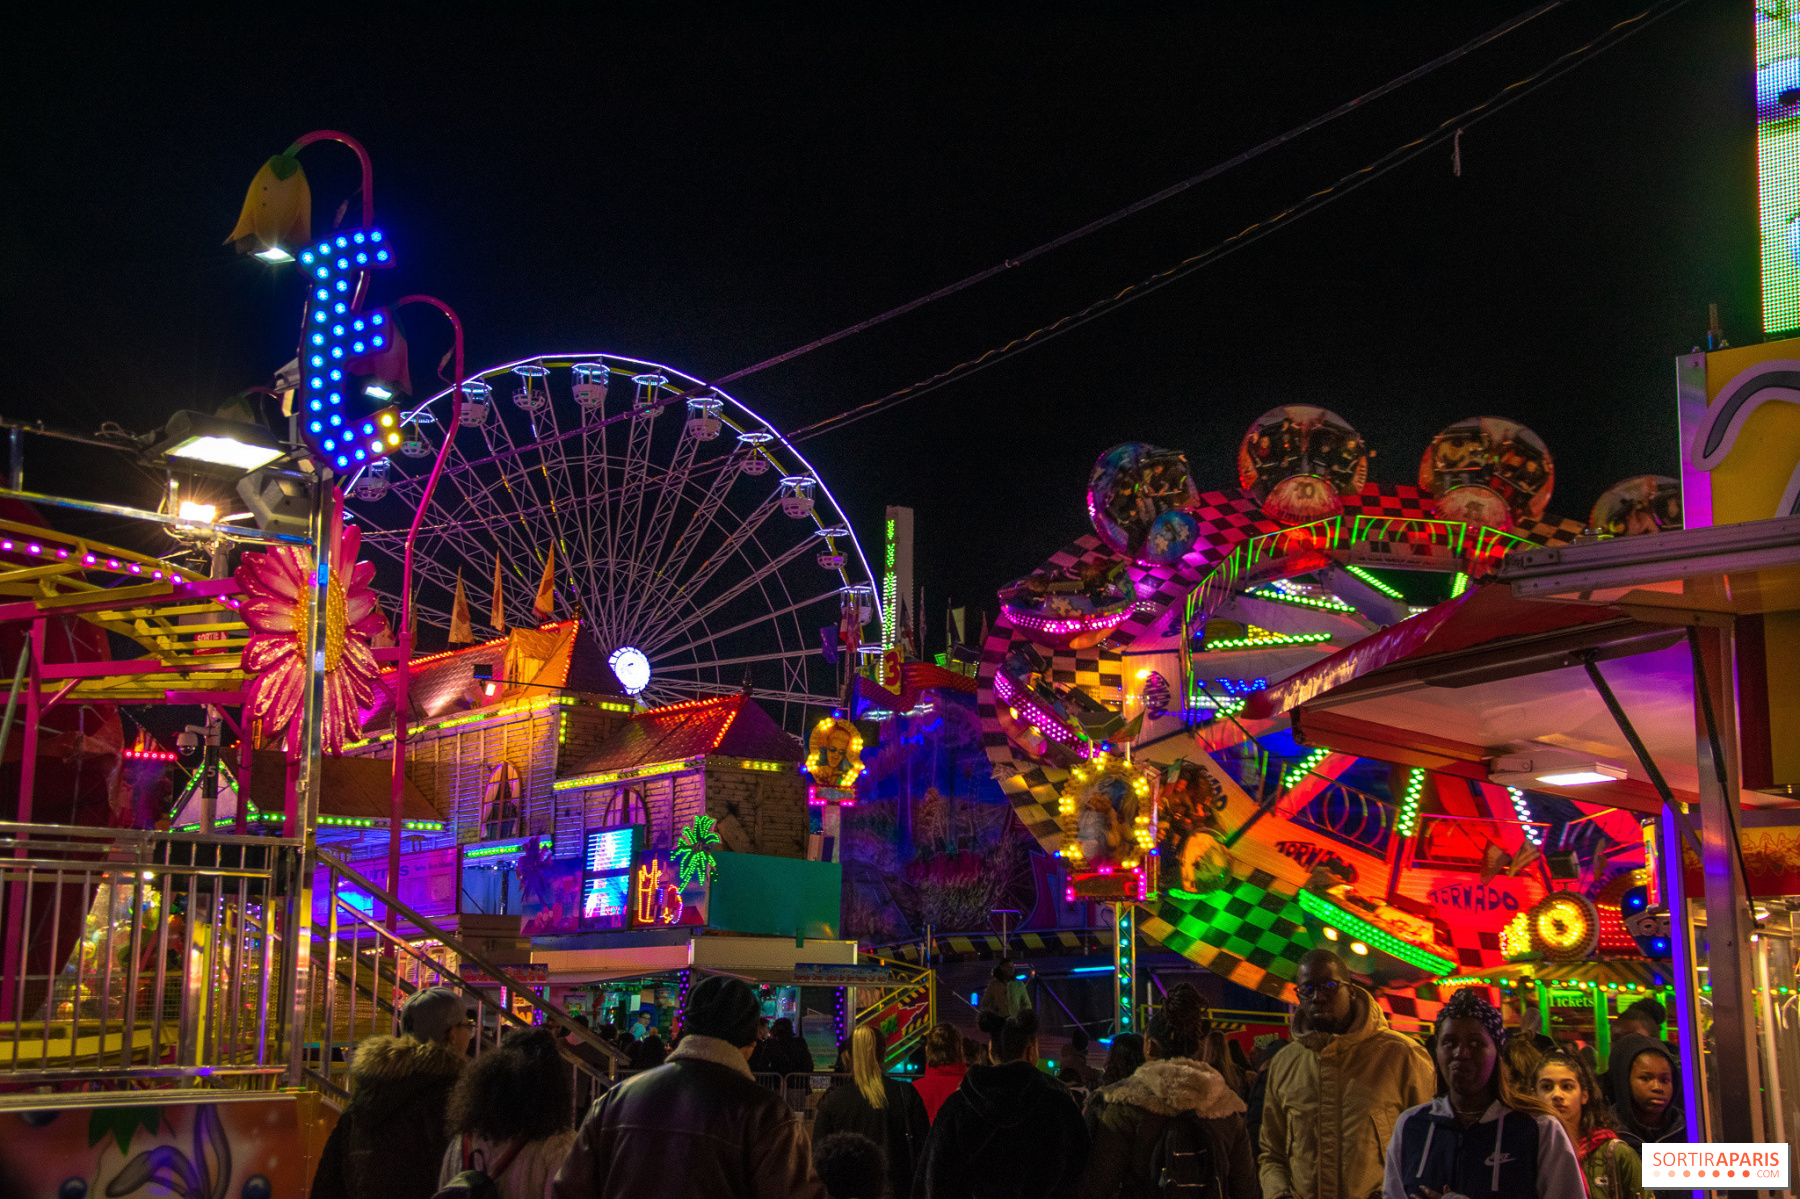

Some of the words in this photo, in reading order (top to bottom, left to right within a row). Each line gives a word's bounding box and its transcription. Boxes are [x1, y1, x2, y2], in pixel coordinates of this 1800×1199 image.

[885, 651, 900, 686] 3
[207, 766, 216, 777] 5
[1429, 883, 1519, 914] TORNADO
[1549, 992, 1595, 1007] Tickets
